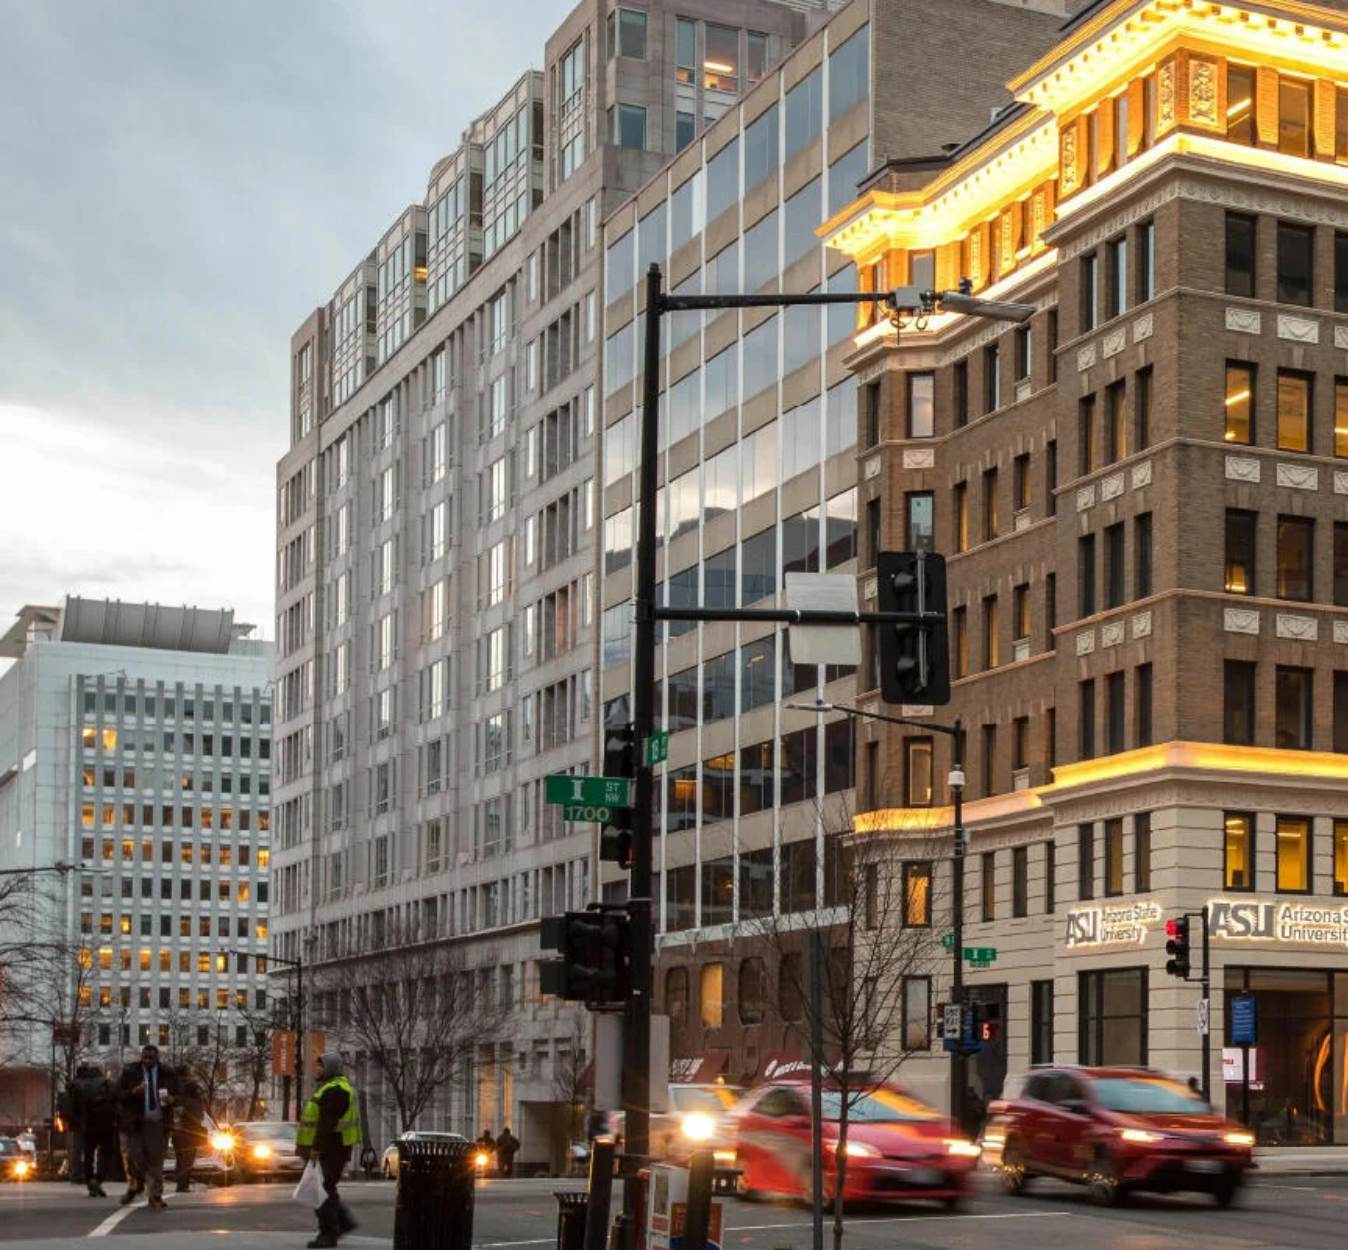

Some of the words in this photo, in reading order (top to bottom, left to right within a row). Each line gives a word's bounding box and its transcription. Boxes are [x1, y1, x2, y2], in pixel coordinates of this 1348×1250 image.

[571, 780, 584, 801] I
[605, 782, 620, 791] ST
[605, 793, 620, 802] NW
[567, 807, 609, 820] 1700
[1066, 911, 1097, 944] ASU
[1101, 906, 1132, 923] Arizona
[1133, 904, 1156, 918] State
[1209, 903, 1275, 937] ASU
[1281, 907, 1341, 923] Arizona
[1101, 925, 1142, 943] University
